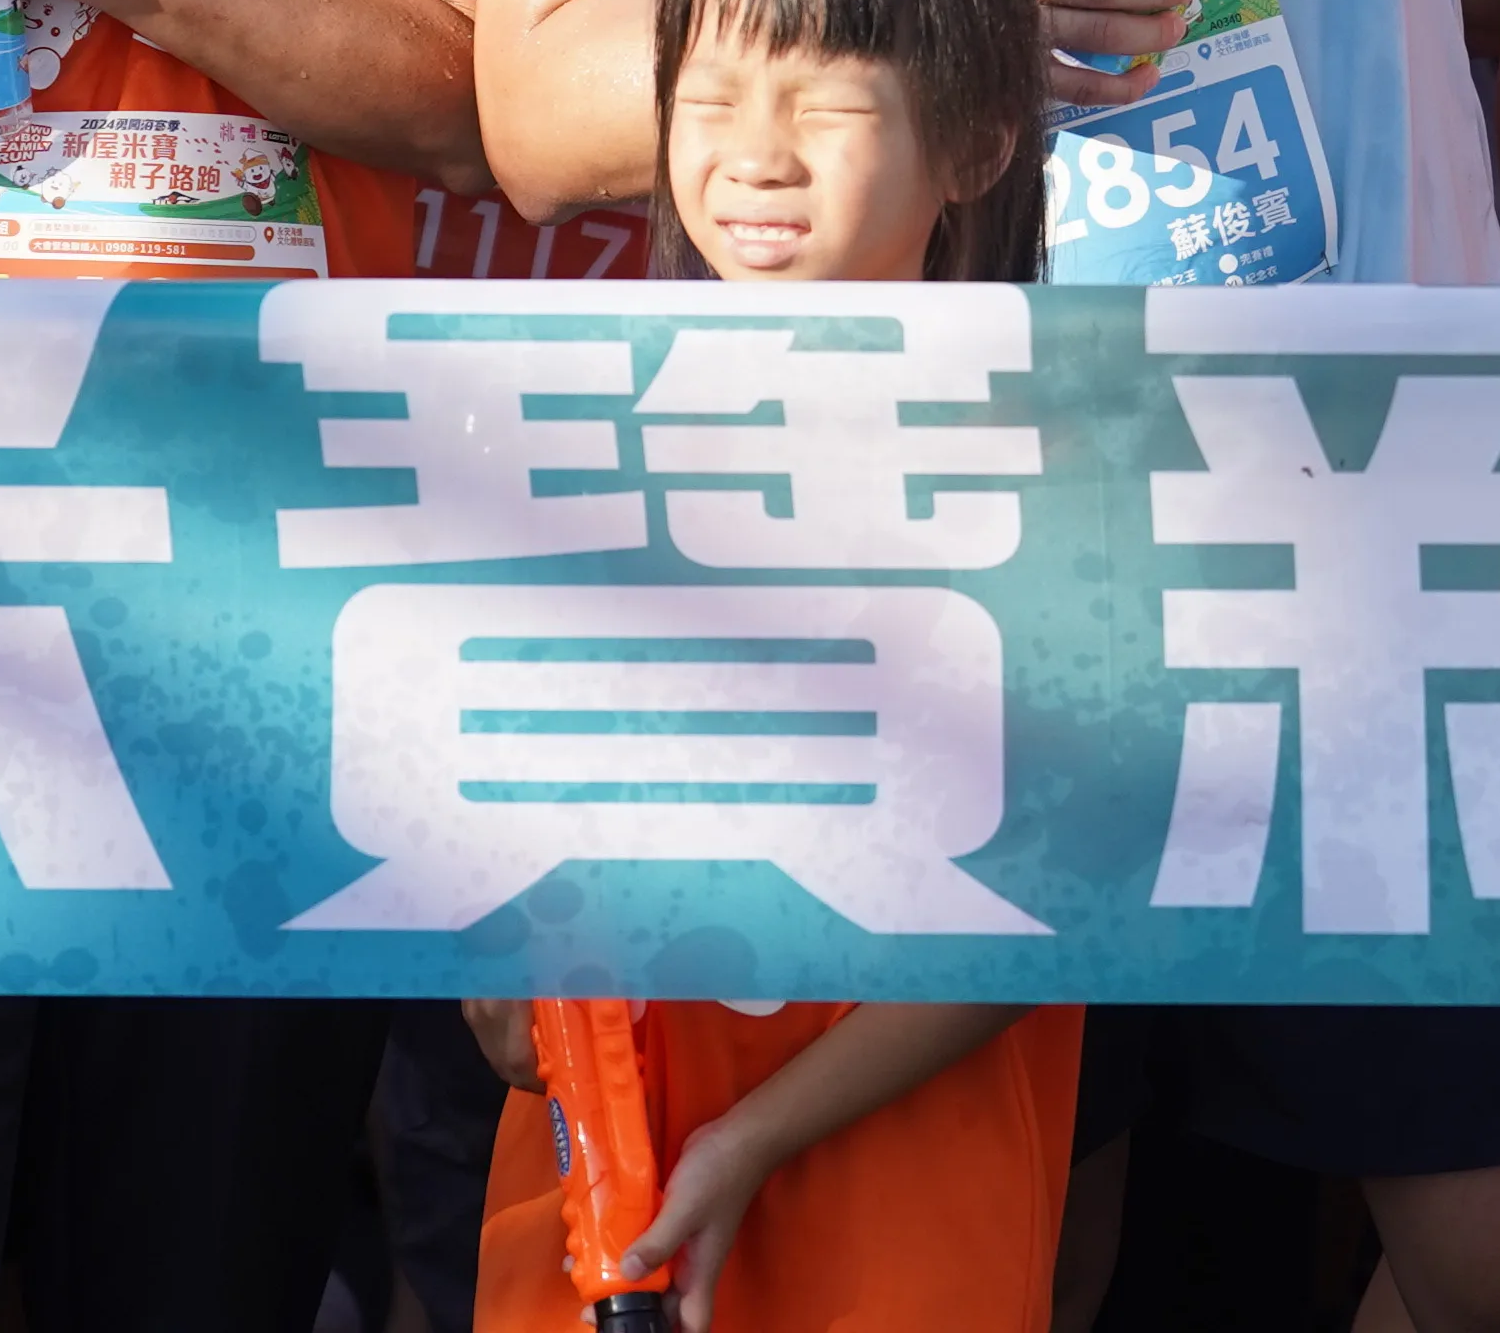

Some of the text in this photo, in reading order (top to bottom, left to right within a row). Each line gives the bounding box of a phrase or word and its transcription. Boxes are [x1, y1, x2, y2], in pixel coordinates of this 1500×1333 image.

[1210, 13, 1243, 31] A0340
[62, 131, 179, 161] 新屋米寶
[109, 162, 221, 193] 親子路跑
[1043, 87, 1280, 247] 2854
[1166, 187, 1297, 262] 蘇俊賓
[105, 242, 187, 255] 0908-119-581
